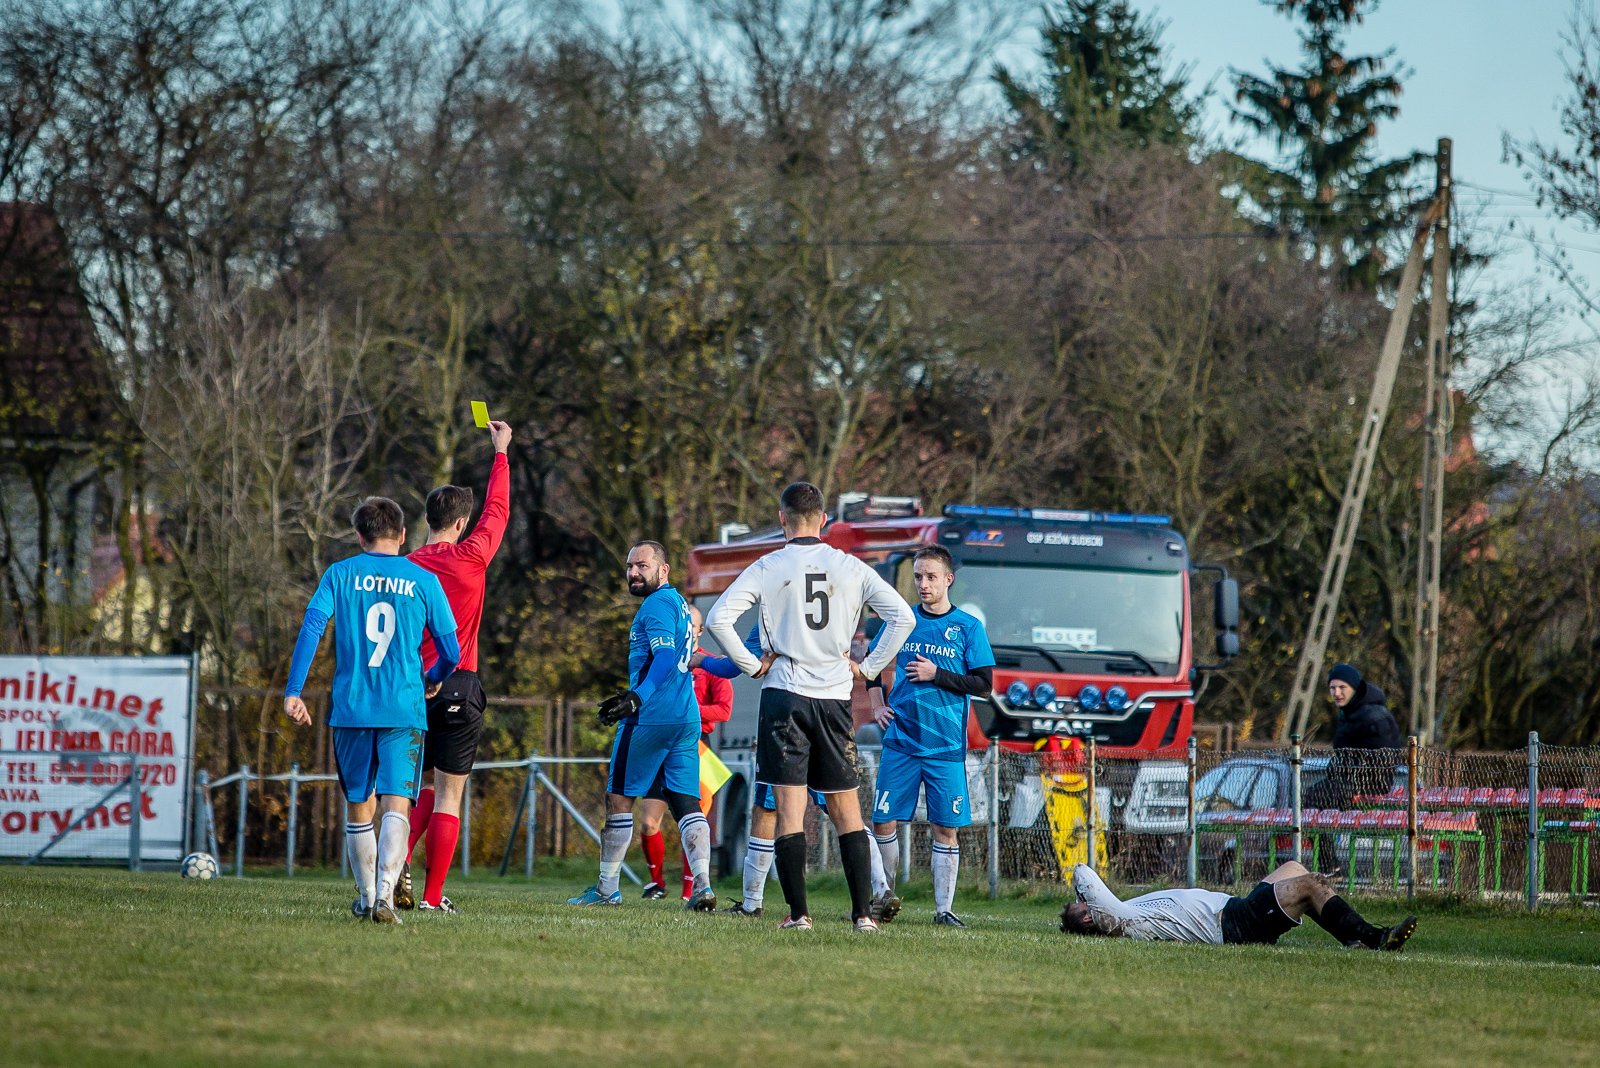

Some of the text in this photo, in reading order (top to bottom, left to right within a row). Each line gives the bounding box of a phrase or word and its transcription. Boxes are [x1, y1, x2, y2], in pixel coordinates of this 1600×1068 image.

[355, 575, 416, 598] LOTNIK
[805, 573, 829, 630] 5
[366, 602, 396, 667] 9
[925, 644, 956, 658] TRANS
[0, 672, 164, 725] niki.net
[1032, 719, 1093, 735] MAN
[110, 726, 174, 756] GÓRA
[140, 764, 176, 785] 720
[874, 789, 890, 814] 14
